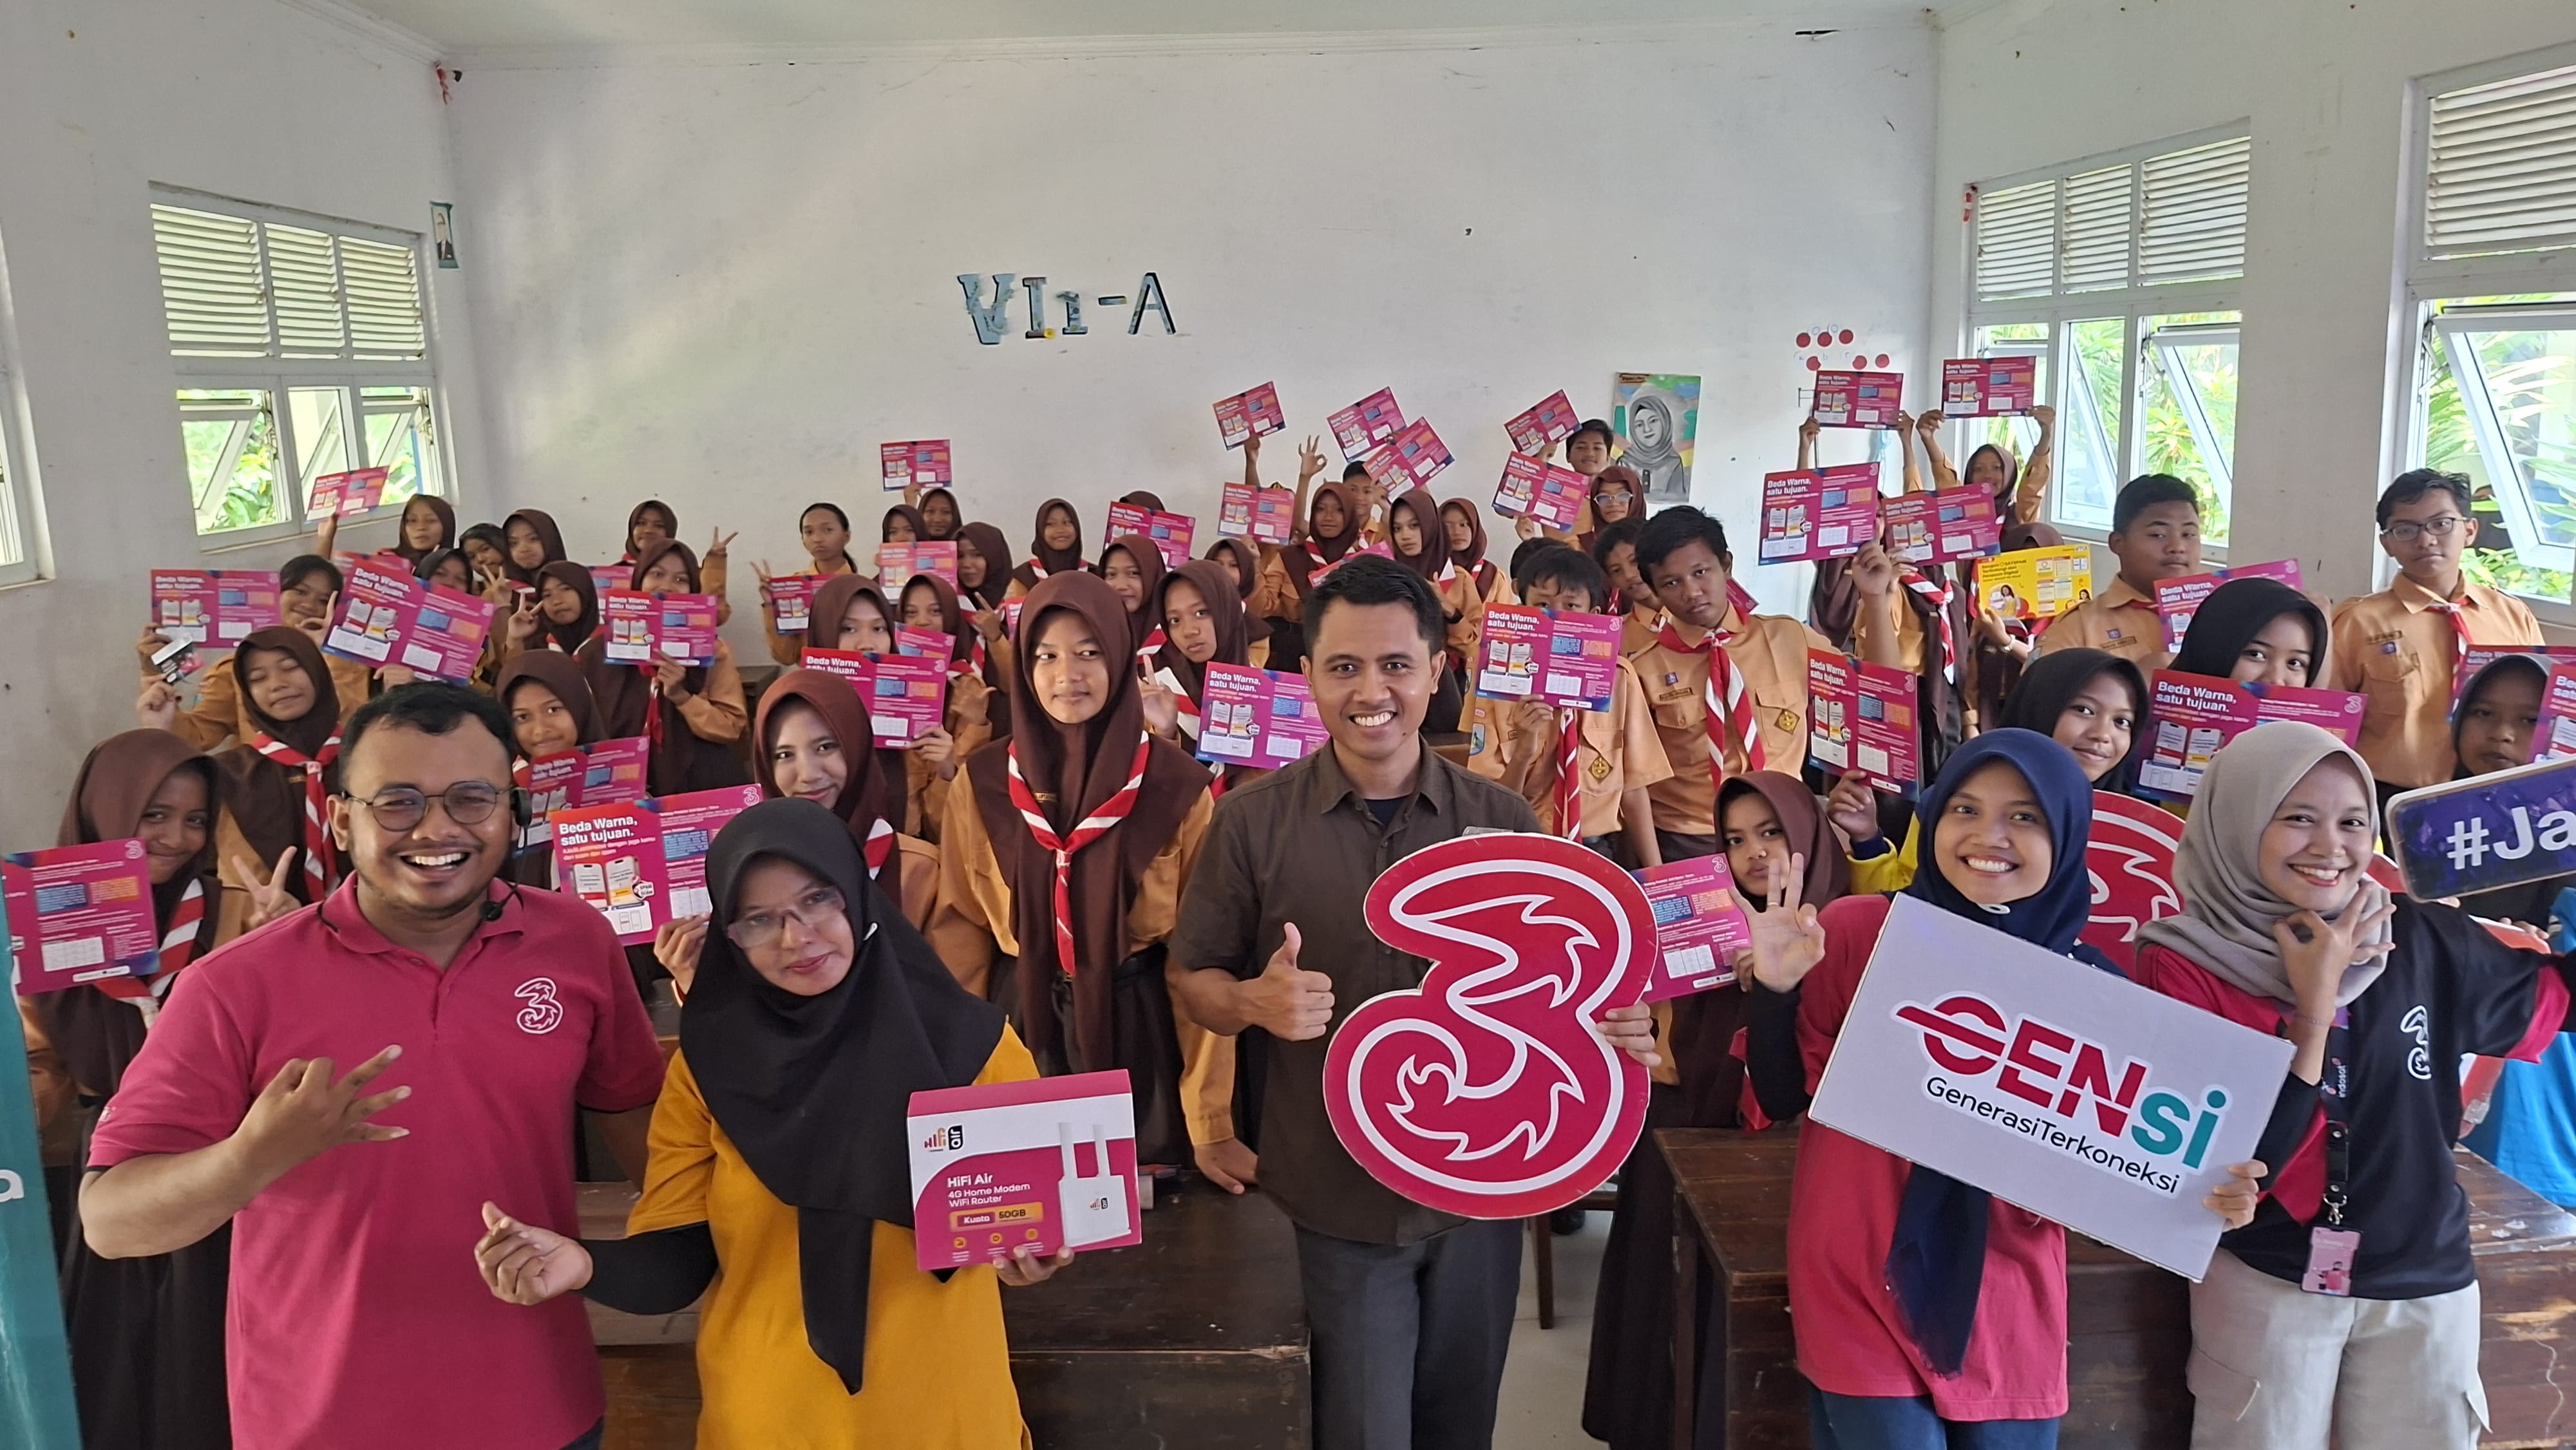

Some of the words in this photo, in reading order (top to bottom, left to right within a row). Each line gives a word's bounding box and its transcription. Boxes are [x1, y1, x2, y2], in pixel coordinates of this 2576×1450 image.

[1487, 619, 1506, 628] satu
[1507, 621, 1536, 631] tujuan.
[1488, 610, 1510, 621] Beda
[1511, 613, 1540, 625] Warna,
[831, 657, 862, 668] Warna,
[1210, 670, 1232, 681] Beda
[1233, 673, 1261, 685] Warna,
[1209, 679, 1227, 688] satu
[1229, 681, 1257, 692] tujuan.
[2158, 681, 2190, 695] Beda
[2193, 686, 2237, 704] Warna,
[2155, 693, 2183, 705] satu
[2186, 697, 2230, 713] tujuan.
[559, 821, 592, 835] Beda
[593, 816, 638, 829] Warna,
[560, 833, 589, 846] satu
[591, 828, 634, 843] tujuan.
[1926, 1077, 2181, 1194] GenerasiTerkoneksi
[947, 1174, 972, 1188] HiFi
[974, 1172, 993, 1185] Air
[948, 1190, 962, 1199] 4G
[963, 1187, 992, 1198] Home
[993, 1183, 1031, 1194] Modem
[949, 1198, 970, 1208] WiFi
[971, 1194, 1003, 1205] Router
[998, 1209, 1027, 1219] 50GB
